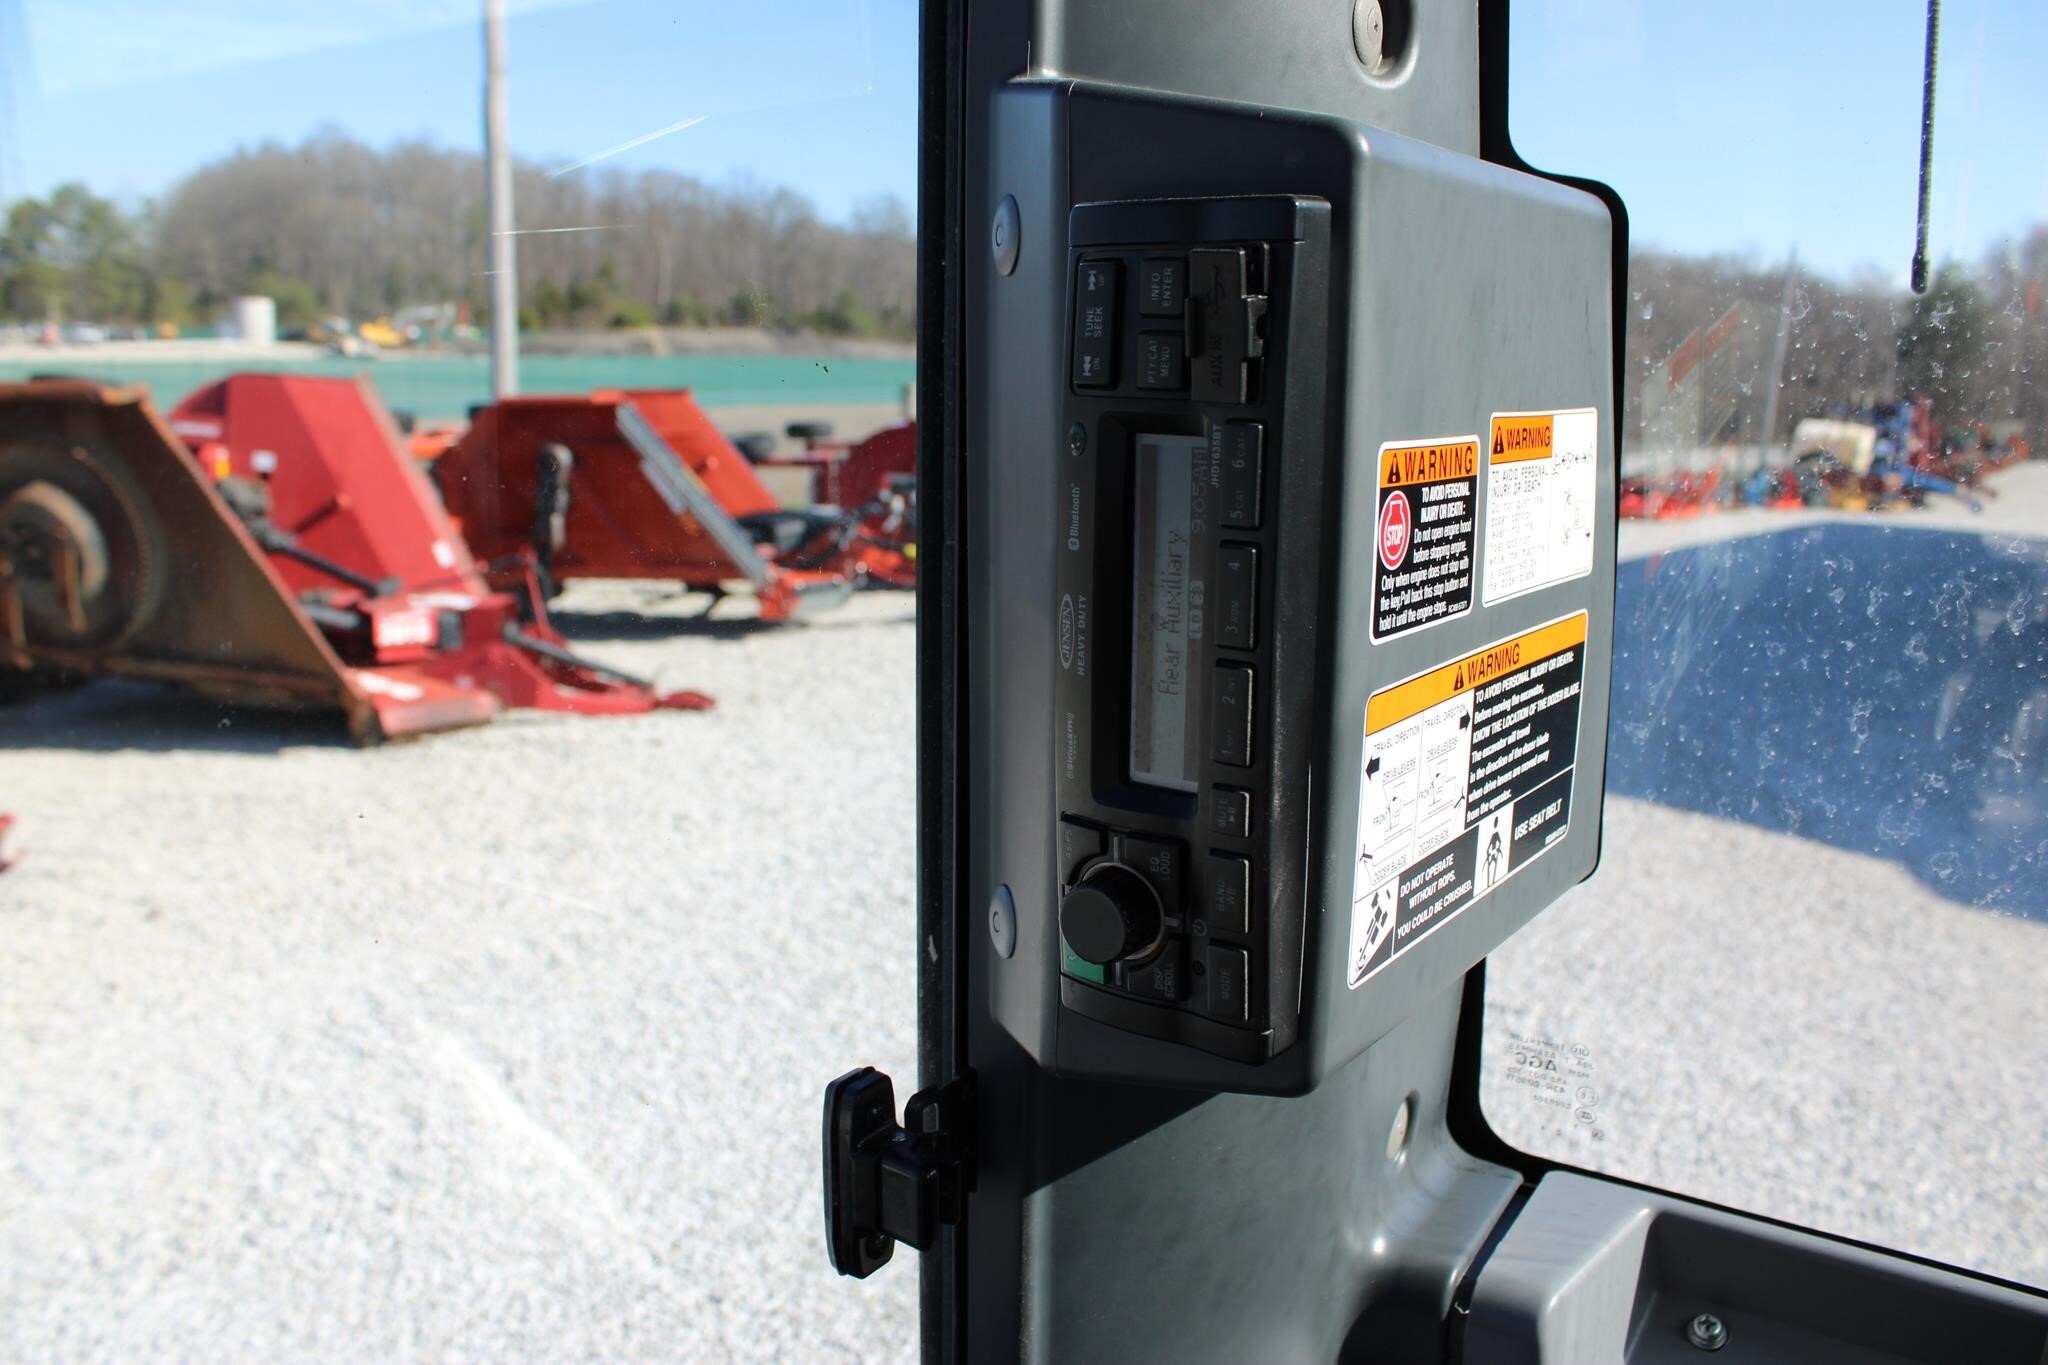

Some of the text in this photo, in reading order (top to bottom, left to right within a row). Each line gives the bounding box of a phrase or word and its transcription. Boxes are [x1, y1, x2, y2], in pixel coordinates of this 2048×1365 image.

[1152, 273, 1160, 301] INFO
[1162, 267, 1173, 307] ENTER
[1085, 306, 1094, 336] TUNE
[1094, 306, 1103, 338] SEEK
[1147, 340, 1158, 383] PTY/CAT
[1159, 346, 1170, 377] MENU
[1209, 355, 1223, 388] AUX
[1507, 426, 1550, 450] WARNING
[1211, 424, 1222, 488] JHD1635BT
[1232, 460, 1245, 469] 6
[1405, 446, 1472, 482] WARNING
[1492, 465, 1548, 483] TO AVOID PERSONAL
[1191, 449, 1207, 533] 9:05AM
[1422, 481, 1470, 503] TO AVOID PERSONAL
[1070, 487, 1080, 536] Bluetooth
[1230, 510, 1243, 520] 5
[1421, 505, 1439, 523] INJURY
[1440, 504, 1448, 519] OR
[1387, 524, 1403, 547] STOP
[1414, 518, 1472, 543] Do not open engine hood
[1227, 562, 1240, 571] 4
[1413, 539, 1467, 563] before stopping engine.
[1381, 575, 1395, 592] Only
[1396, 572, 1410, 587] when
[1411, 567, 1427, 586] engine
[1428, 562, 1440, 578] does
[1449, 560, 1459, 574] stop
[1460, 556, 1469, 570] with
[1381, 596, 1389, 611] the
[1411, 586, 1423, 603] back
[1424, 584, 1432, 599] this
[1434, 582, 1444, 597] stop
[1445, 578, 1459, 593] button
[1460, 573, 1469, 588] and
[1156, 530, 1187, 696] Rear Auxiliary
[1379, 615, 1391, 631] hold
[1397, 611, 1407, 626] until
[1408, 608, 1416, 623] the
[1417, 604, 1433, 622] engine
[1434, 601, 1447, 616] stops.
[1062, 606, 1071, 658] JENSEN
[1077, 594, 1086, 676] HEAVY DUTY
[1224, 625, 1239, 635] 3
[1468, 643, 1520, 684] WARNING
[1476, 690, 1484, 704] TO
[1484, 682, 1502, 700] AVOID
[1502, 670, 1530, 692] PERSONAL
[1530, 661, 1548, 680] INJURY
[1549, 657, 1556, 671] OR
[1222, 695, 1235, 704] 2
[1474, 708, 1491, 724] Before
[1492, 699, 1511, 716] moving
[1512, 694, 1520, 707] the
[1473, 725, 1491, 744] KNOW
[1491, 719, 1503, 735] THE
[1503, 706, 1529, 729] LOCATION
[1529, 702, 1537, 716] OF
[1537, 697, 1547, 712] THE
[1547, 690, 1564, 707] DOZER
[1472, 750, 1482, 764] The
[1508, 730, 1517, 745] will
[1516, 723, 1531, 740] travel
[1470, 772, 1476, 784] in
[1476, 768, 1485, 780] the
[1508, 749, 1514, 763] of
[1514, 747, 1523, 760] the
[1469, 789, 1483, 803] when
[1466, 808, 1480, 823] from
[1480, 802, 1489, 815] the
[1515, 820, 1529, 840] USE
[1529, 809, 1546, 831] SEAT
[1545, 798, 1562, 820] BELT
[1151, 857, 1160, 872] EQ
[1161, 852, 1171, 880] LOUD
[1400, 853, 1454, 898] DO NOT OPERATE
[1216, 880, 1225, 911] BAND
[1226, 888, 1236, 906] WB
[1409, 870, 1456, 909] WITHOUT ROPS.
[1397, 880, 1472, 939] YOU COULD BE CRUSHED.
[1155, 968, 1163, 990] DISP
[1164, 963, 1175, 999] SCROLL
[1221, 968, 1230, 1000] MODE
